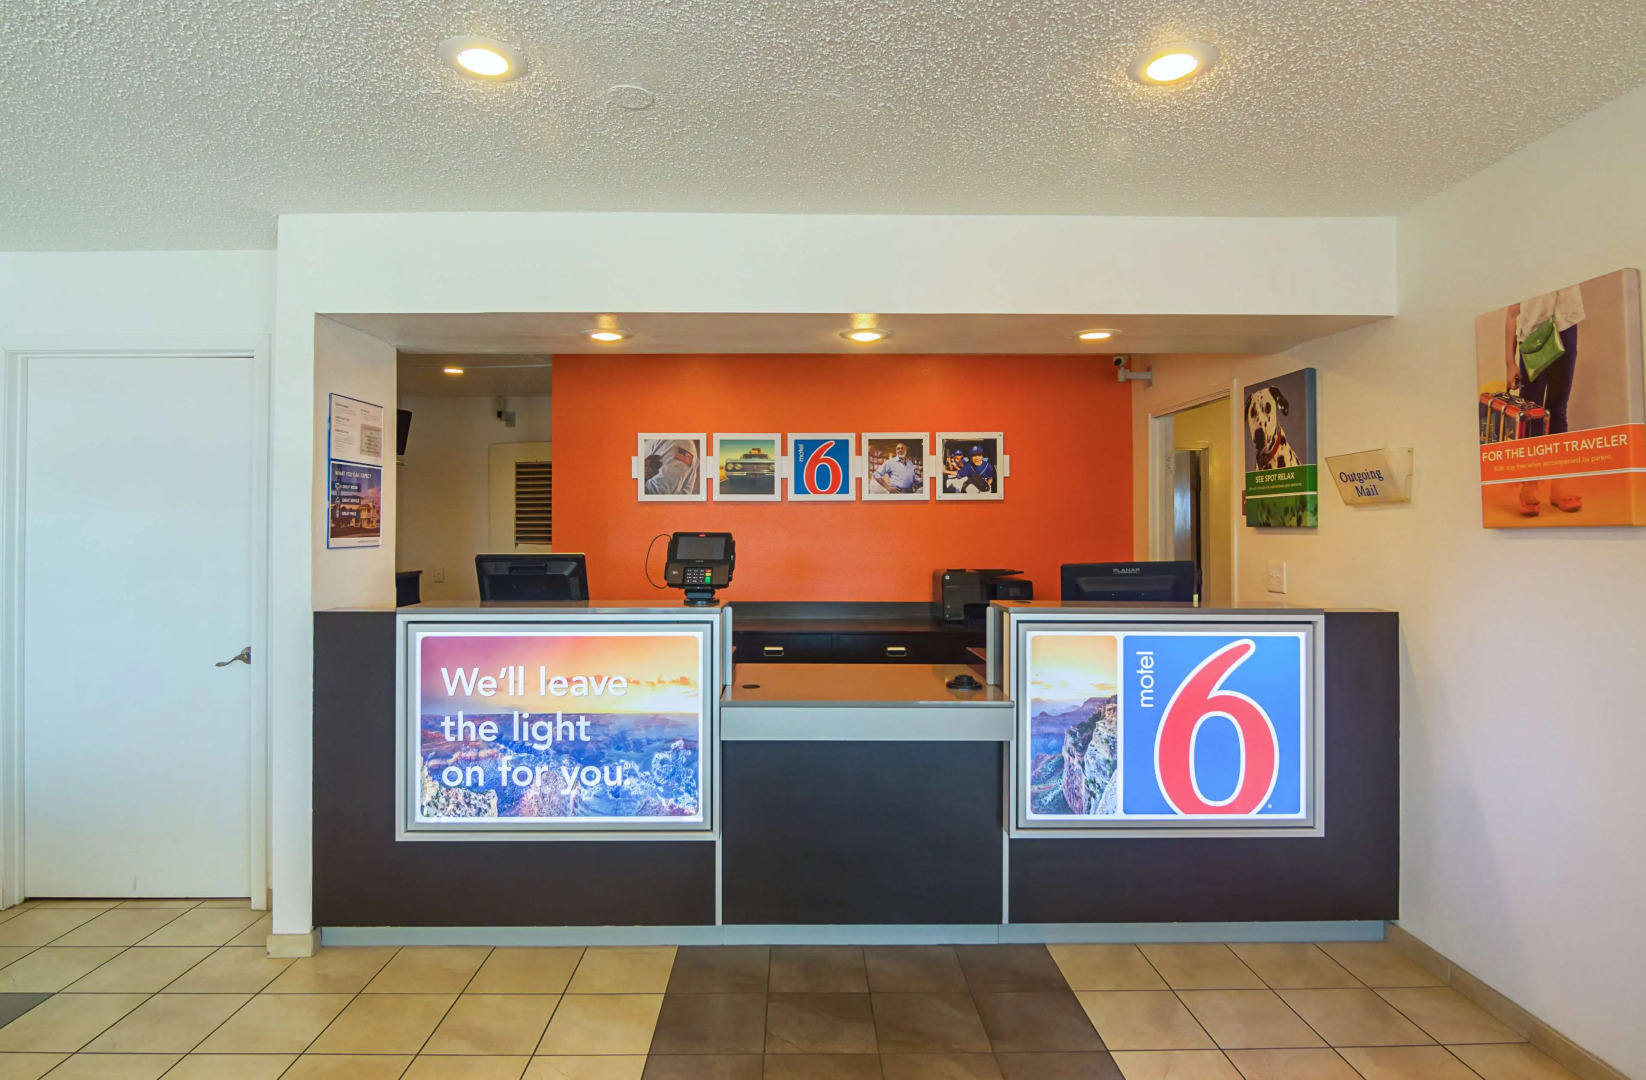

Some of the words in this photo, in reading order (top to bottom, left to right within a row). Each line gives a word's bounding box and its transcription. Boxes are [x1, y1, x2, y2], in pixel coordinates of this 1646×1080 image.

[1482, 450, 1502, 462] FOR
[1505, 447, 1525, 459] THE
[1527, 443, 1560, 457] LIGHT
[1563, 434, 1628, 452] TRAVELER
[803, 440, 842, 494] 6
[1255, 475, 1264, 483] SEE
[1265, 474, 1277, 482] SPOT
[1278, 472, 1295, 480] RELAX
[1339, 468, 1384, 484] Outgoing
[1355, 484, 1379, 497] Mail
[441, 665, 525, 697] We'll
[540, 665, 628, 697] leave
[441, 711, 499, 742] the
[513, 711, 591, 750] light
[1136, 651, 1154, 708] motel
[1154, 638, 1280, 815] 6
[441, 765, 484, 787] on
[498, 755, 548, 787] for
